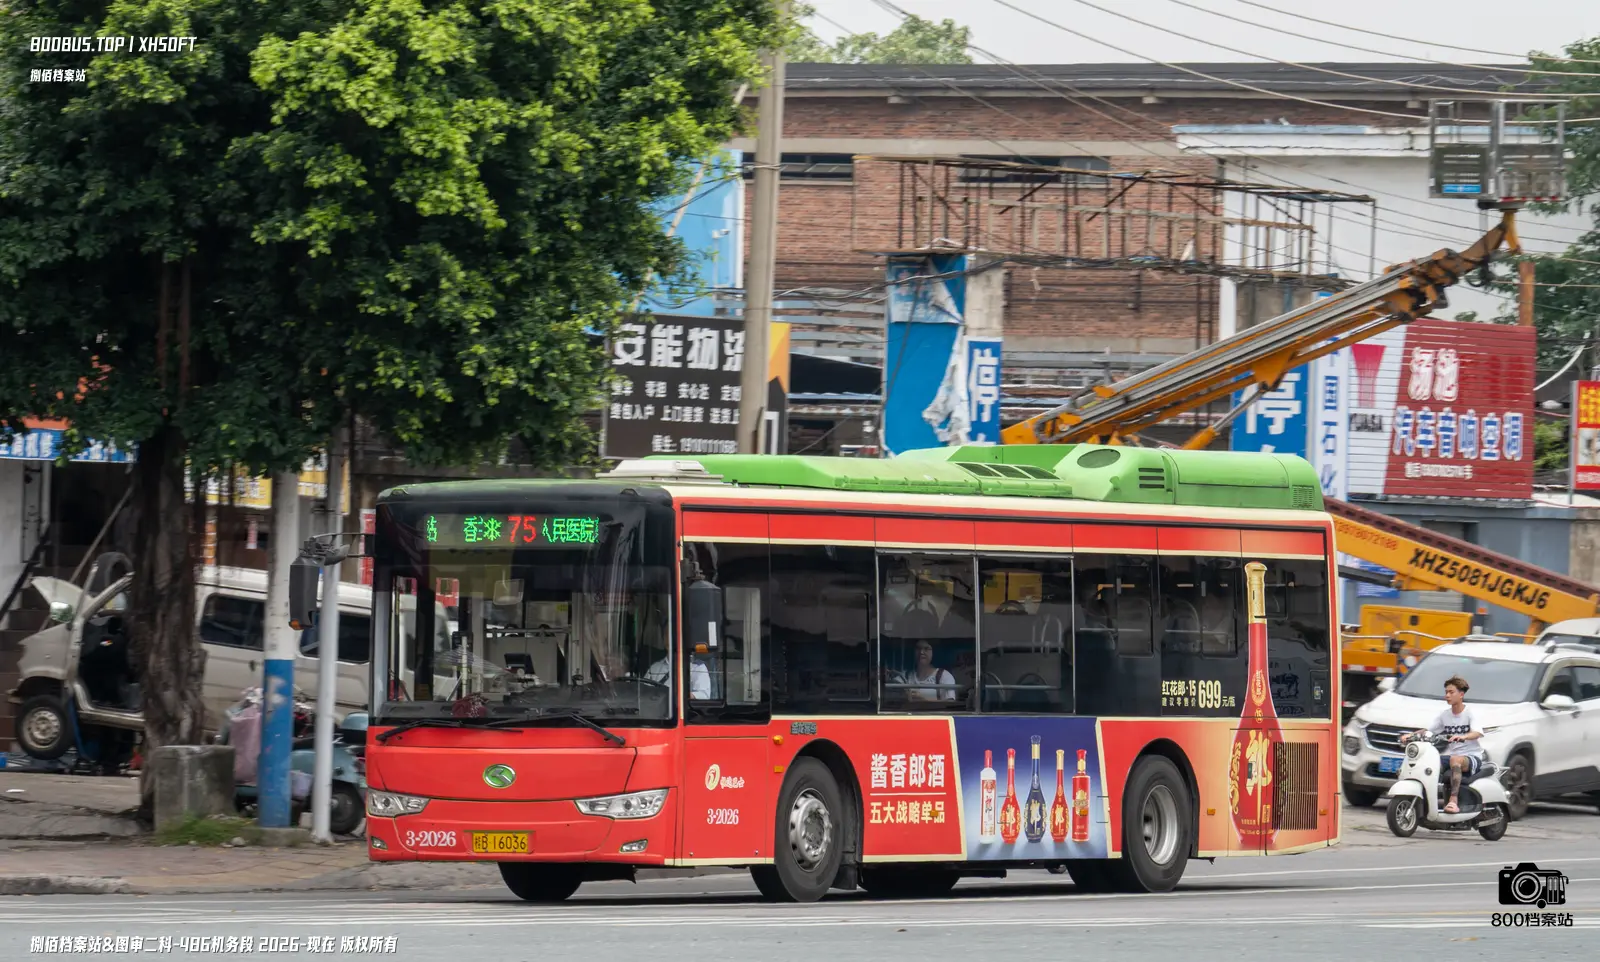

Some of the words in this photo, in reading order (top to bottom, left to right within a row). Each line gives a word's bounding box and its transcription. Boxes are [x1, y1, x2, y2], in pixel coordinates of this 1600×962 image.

[969, 347, 999, 446] 停
[1240, 372, 1302, 454] 停
[1393, 405, 1524, 462] 汽车音响空调
[508, 515, 537, 543] 75
[1408, 547, 1551, 610] XHZ5081JGKJ6
[1198, 679, 1222, 709] 699
[871, 753, 945, 788] 酱香郎酒
[705, 808, 740, 826] 3-2026
[869, 800, 946, 824] 五大战略单品
[405, 830, 457, 848] 3-2026
